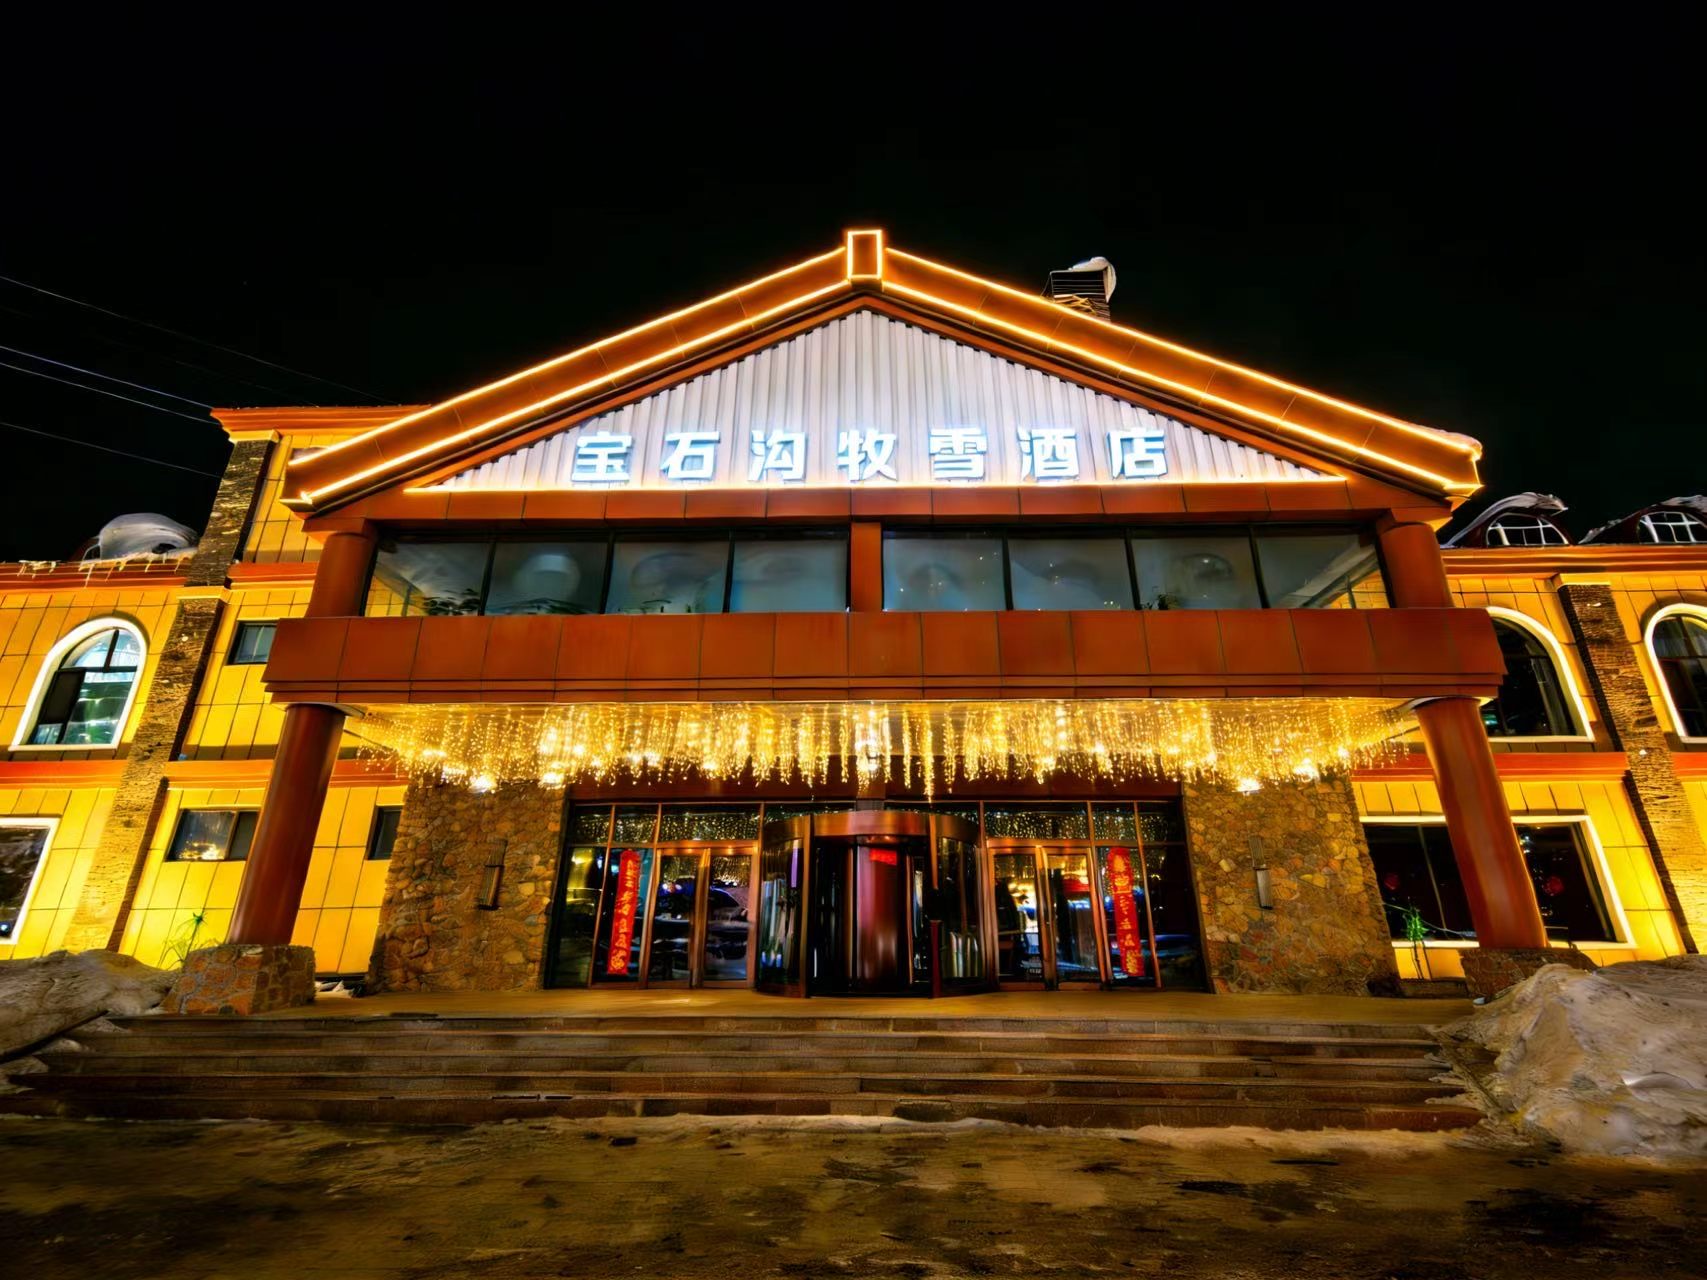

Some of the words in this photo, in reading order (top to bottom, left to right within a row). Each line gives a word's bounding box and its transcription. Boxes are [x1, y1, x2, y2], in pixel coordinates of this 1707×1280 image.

[572, 427, 1168, 484] 宝石沟牧雪酒店
